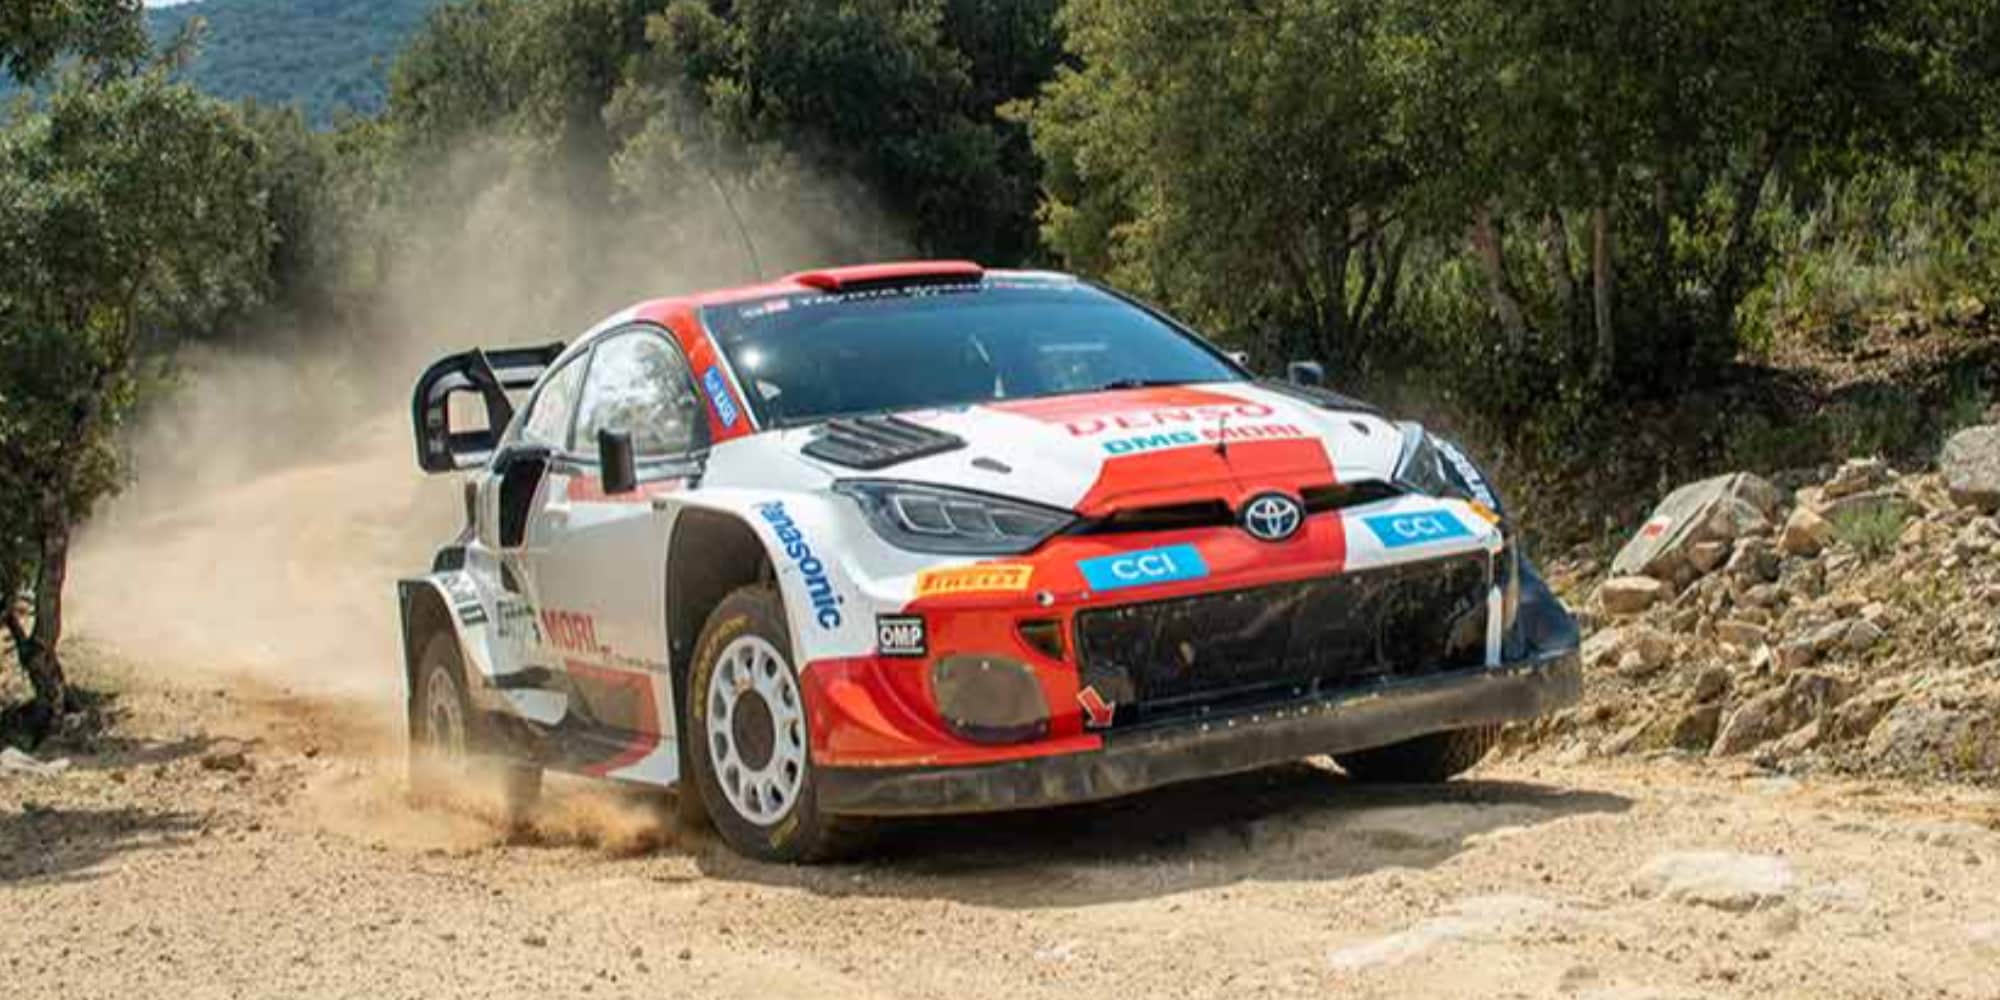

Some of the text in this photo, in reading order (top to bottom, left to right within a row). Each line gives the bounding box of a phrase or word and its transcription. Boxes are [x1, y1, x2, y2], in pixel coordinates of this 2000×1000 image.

[1102, 431, 1199, 454] DMG
[1391, 514, 1447, 538] CCI
[1111, 553, 1177, 580] CCI
[879, 624, 923, 648] OMP
